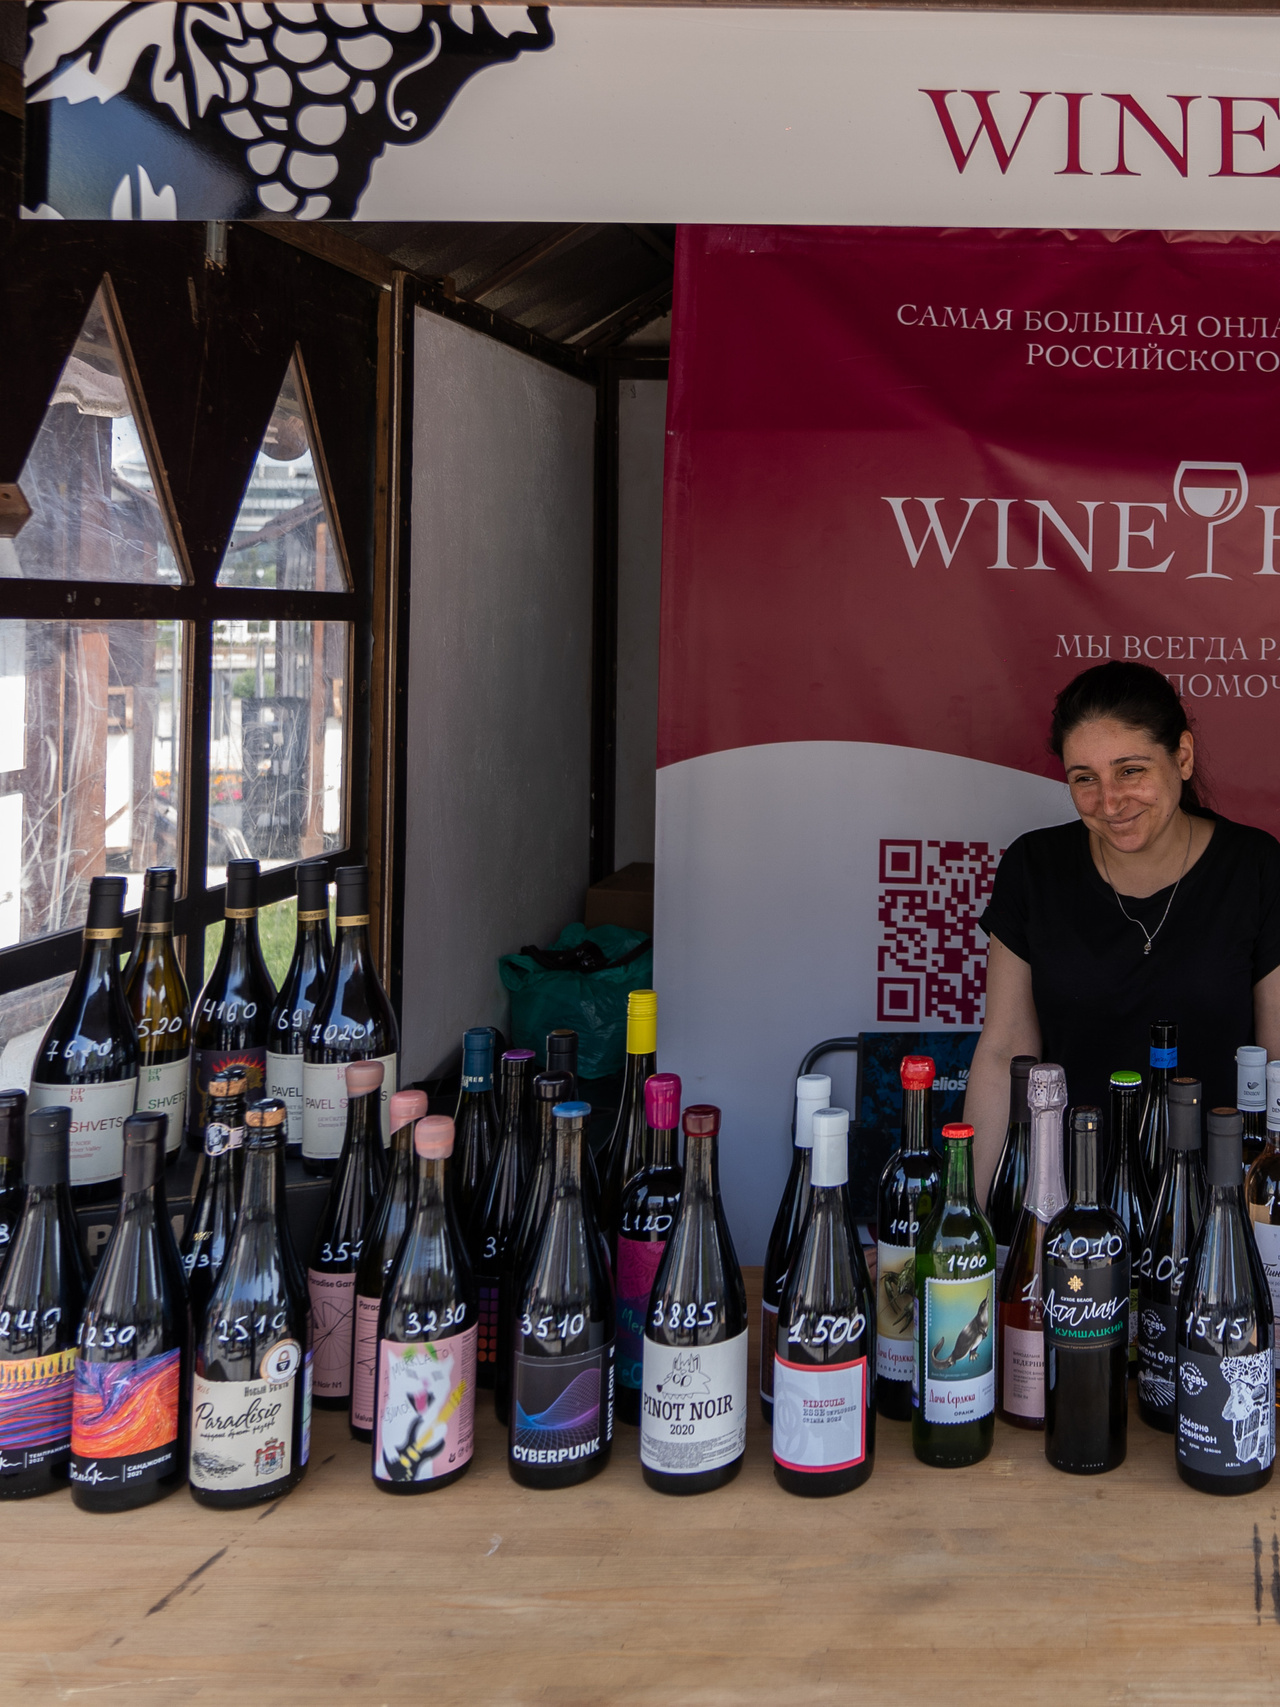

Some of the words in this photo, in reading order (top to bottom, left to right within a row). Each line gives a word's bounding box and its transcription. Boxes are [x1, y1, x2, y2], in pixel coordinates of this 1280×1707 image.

[896, 303, 1014, 331] САМАЯ
[1023, 309, 1188, 337] БОЛЬШАЯ
[1026, 342, 1280, 374] РОССИЙСКОГО
[880, 496, 1176, 573] WINE
[1053, 634, 1112, 659] МЫ
[1123, 634, 1250, 663] ВСЕГДА
[202, 998, 258, 1023] 4160
[277, 1007, 312, 1030] 69
[148, 1089, 187, 1110] SHVETS
[271, 1085, 303, 1098] PAVEL
[305, 1098, 335, 1110] PAVEL
[68, 1116, 124, 1134] SHVETS
[622, 1214, 673, 1232] 1120
[1046, 1233, 1123, 1260] 1.010
[947, 1254, 988, 1272] 1400
[335, 1280, 356, 1289] Gar
[405, 1302, 468, 1335] 3230
[653, 1300, 717, 1328] 3885
[76, 1322, 137, 1348] 1250
[520, 1313, 585, 1338] 3510
[787, 1313, 867, 1344] 1.500
[1055, 1321, 1124, 1339] КУМШАЦКИЙ
[1185, 1311, 1247, 1340] 1515
[1180, 1366, 1208, 1387] Гусевъ
[195, 1397, 282, 1430] Paradisio
[643, 1392, 685, 1421] PINOT
[689, 1394, 734, 1421] NOIR
[803, 1397, 846, 1408] RIDICULE
[803, 1408, 826, 1417] ESSE
[953, 1408, 975, 1417] ОРАНЖ
[669, 1424, 696, 1436] 2020
[1180, 1423, 1218, 1445] Совиньон
[512, 1436, 601, 1464] CYBERPUNK
[126, 1452, 172, 1472] САНДЖОВЕЗЕ
[126, 1470, 143, 1479] 2021
